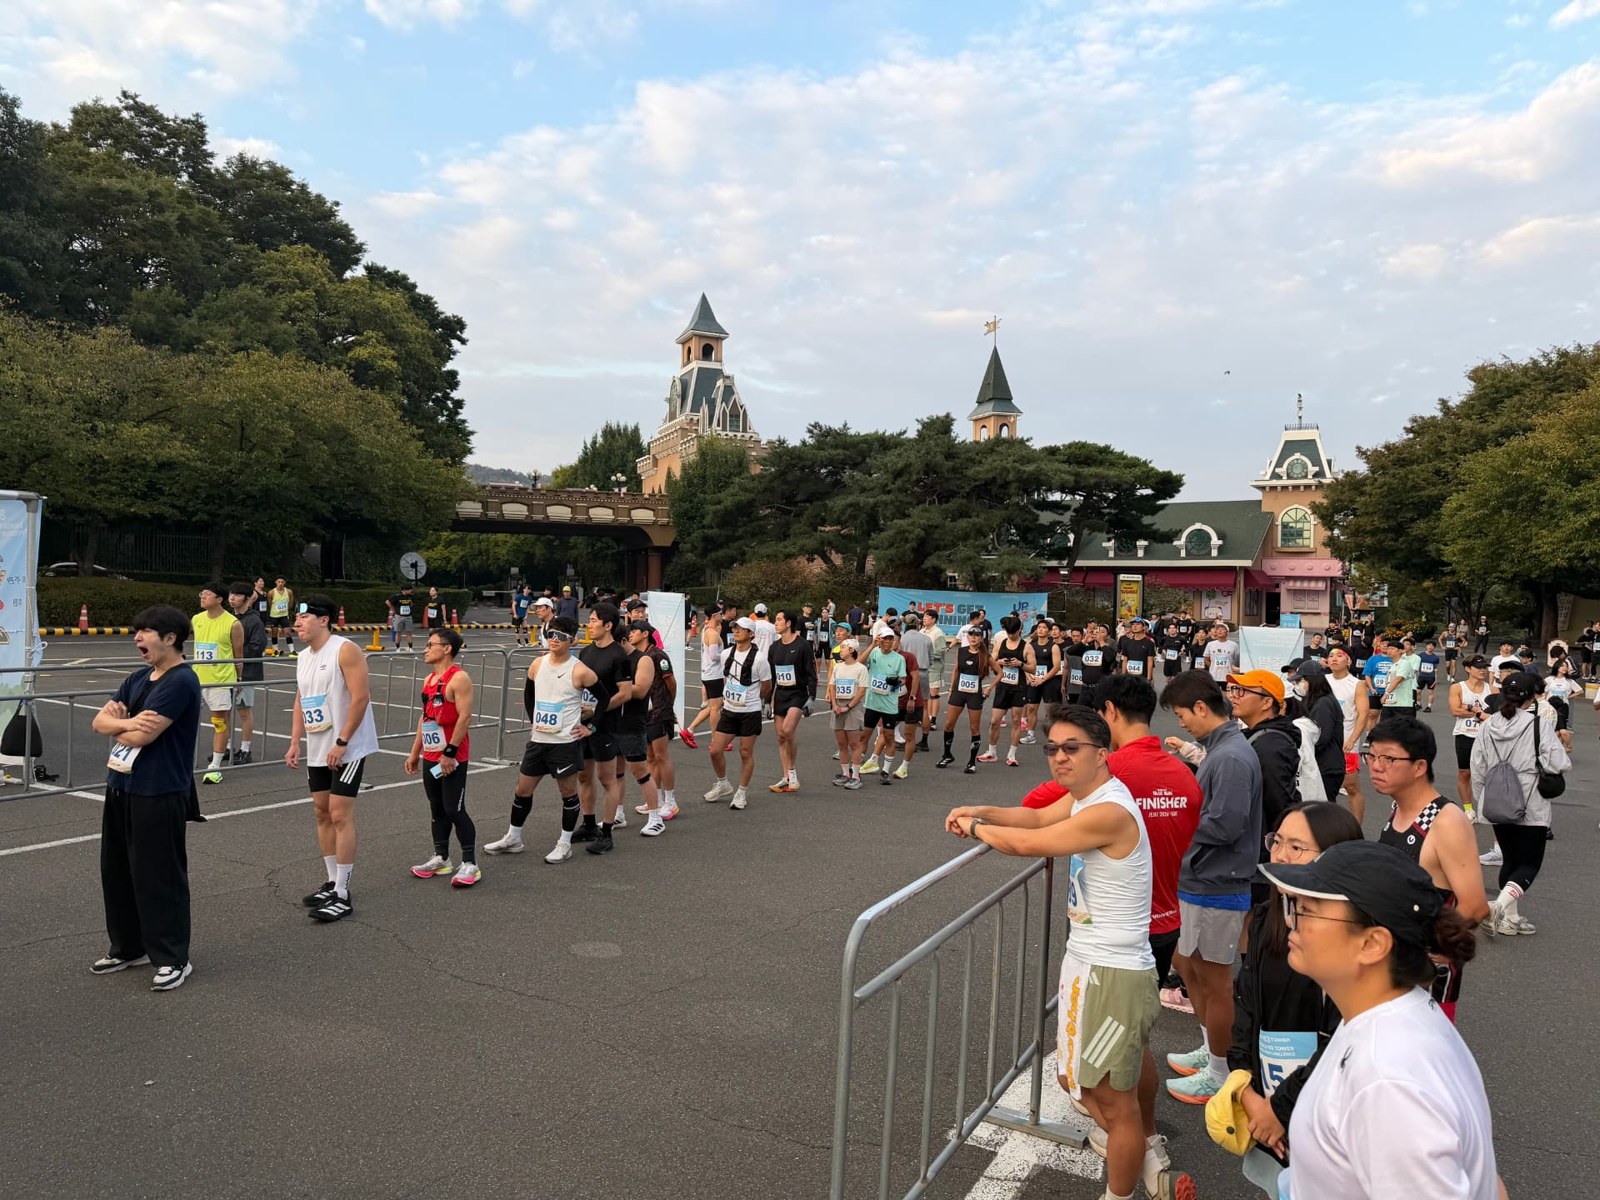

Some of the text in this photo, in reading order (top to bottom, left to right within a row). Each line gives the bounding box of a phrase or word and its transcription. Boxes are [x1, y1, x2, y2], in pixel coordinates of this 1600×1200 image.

[917, 602, 954, 614] LET'S
[1013, 601, 1028, 611] UP
[872, 679, 888, 690] 020
[960, 680, 976, 689] 005
[725, 689, 742, 702] 017
[535, 711, 558, 726] 048
[1465, 719, 1478, 728] 07
[112, 742, 134, 761] 21
[1135, 796, 1188, 810] FINISHER
